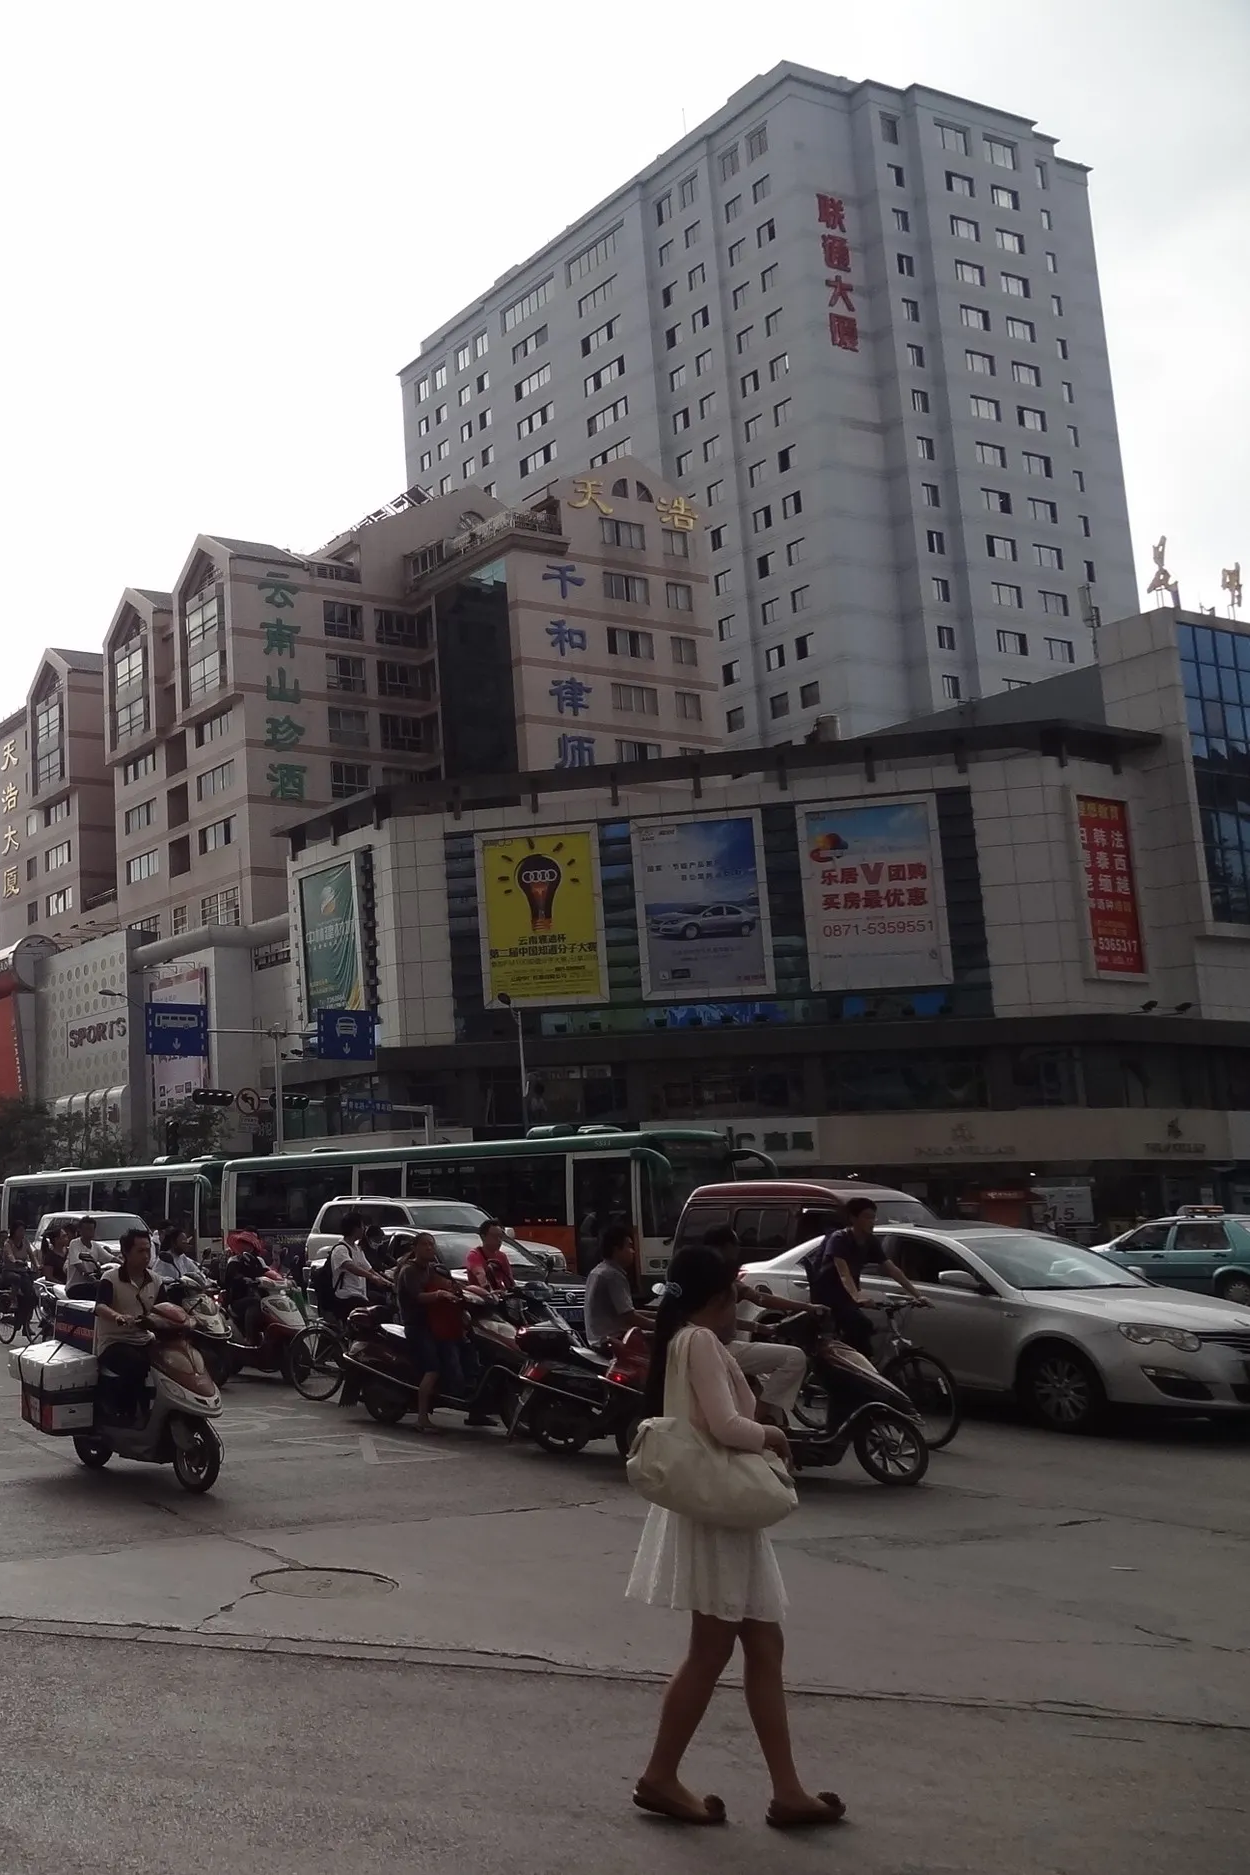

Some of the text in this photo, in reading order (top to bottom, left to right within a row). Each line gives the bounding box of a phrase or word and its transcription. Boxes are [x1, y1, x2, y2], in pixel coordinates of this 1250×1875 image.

[572, 479, 699, 532] 天浩
[542, 563, 597, 770] 千和律师
[257, 571, 308, 802] 云南山珍酒
[0, 736, 22, 899] 天浩大厦
[820, 861, 928, 887] 乐居V团购
[822, 886, 929, 911] 买房最优惠
[822, 919, 934, 937] 0871-5359551
[1097, 937, 1138, 953] 5365317
[68, 1016, 127, 1049] SPORTS
